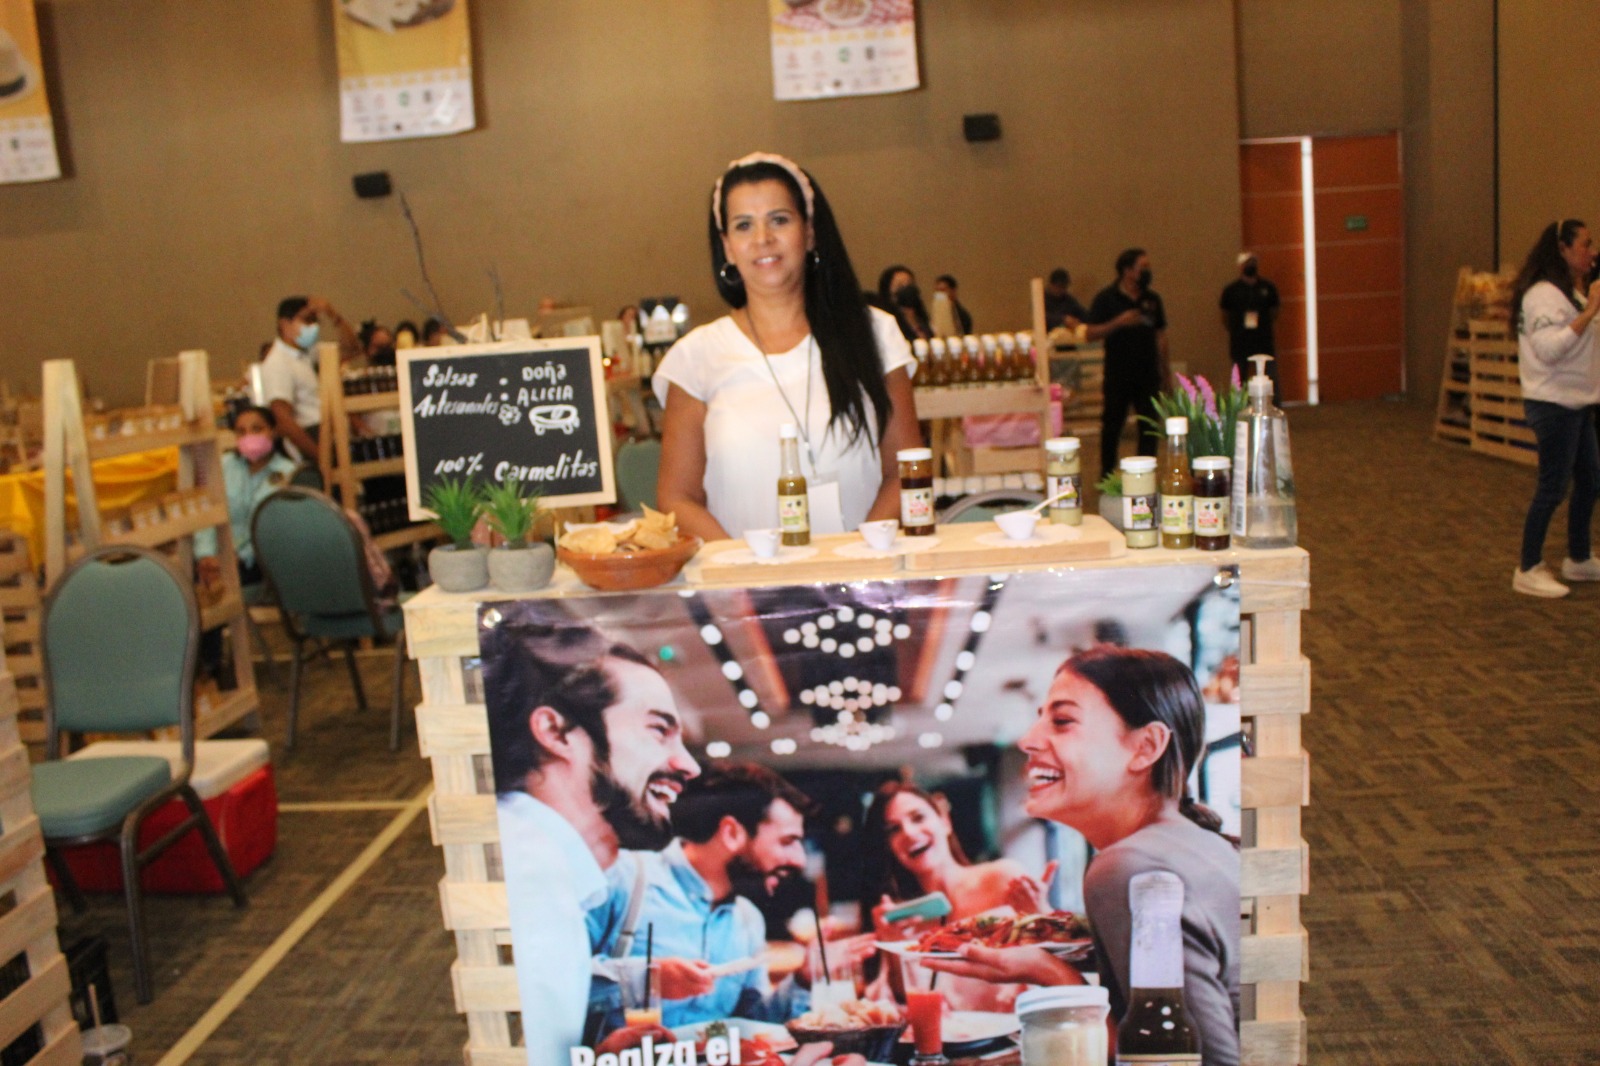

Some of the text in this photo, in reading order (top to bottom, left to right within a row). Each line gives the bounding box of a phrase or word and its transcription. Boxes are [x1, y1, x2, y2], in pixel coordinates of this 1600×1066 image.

[423, 364, 478, 387] Salsas
[517, 385, 573, 407] ALICIA
[434, 449, 598, 482] 100% Carmelitas
[705, 1027, 742, 1066] el
